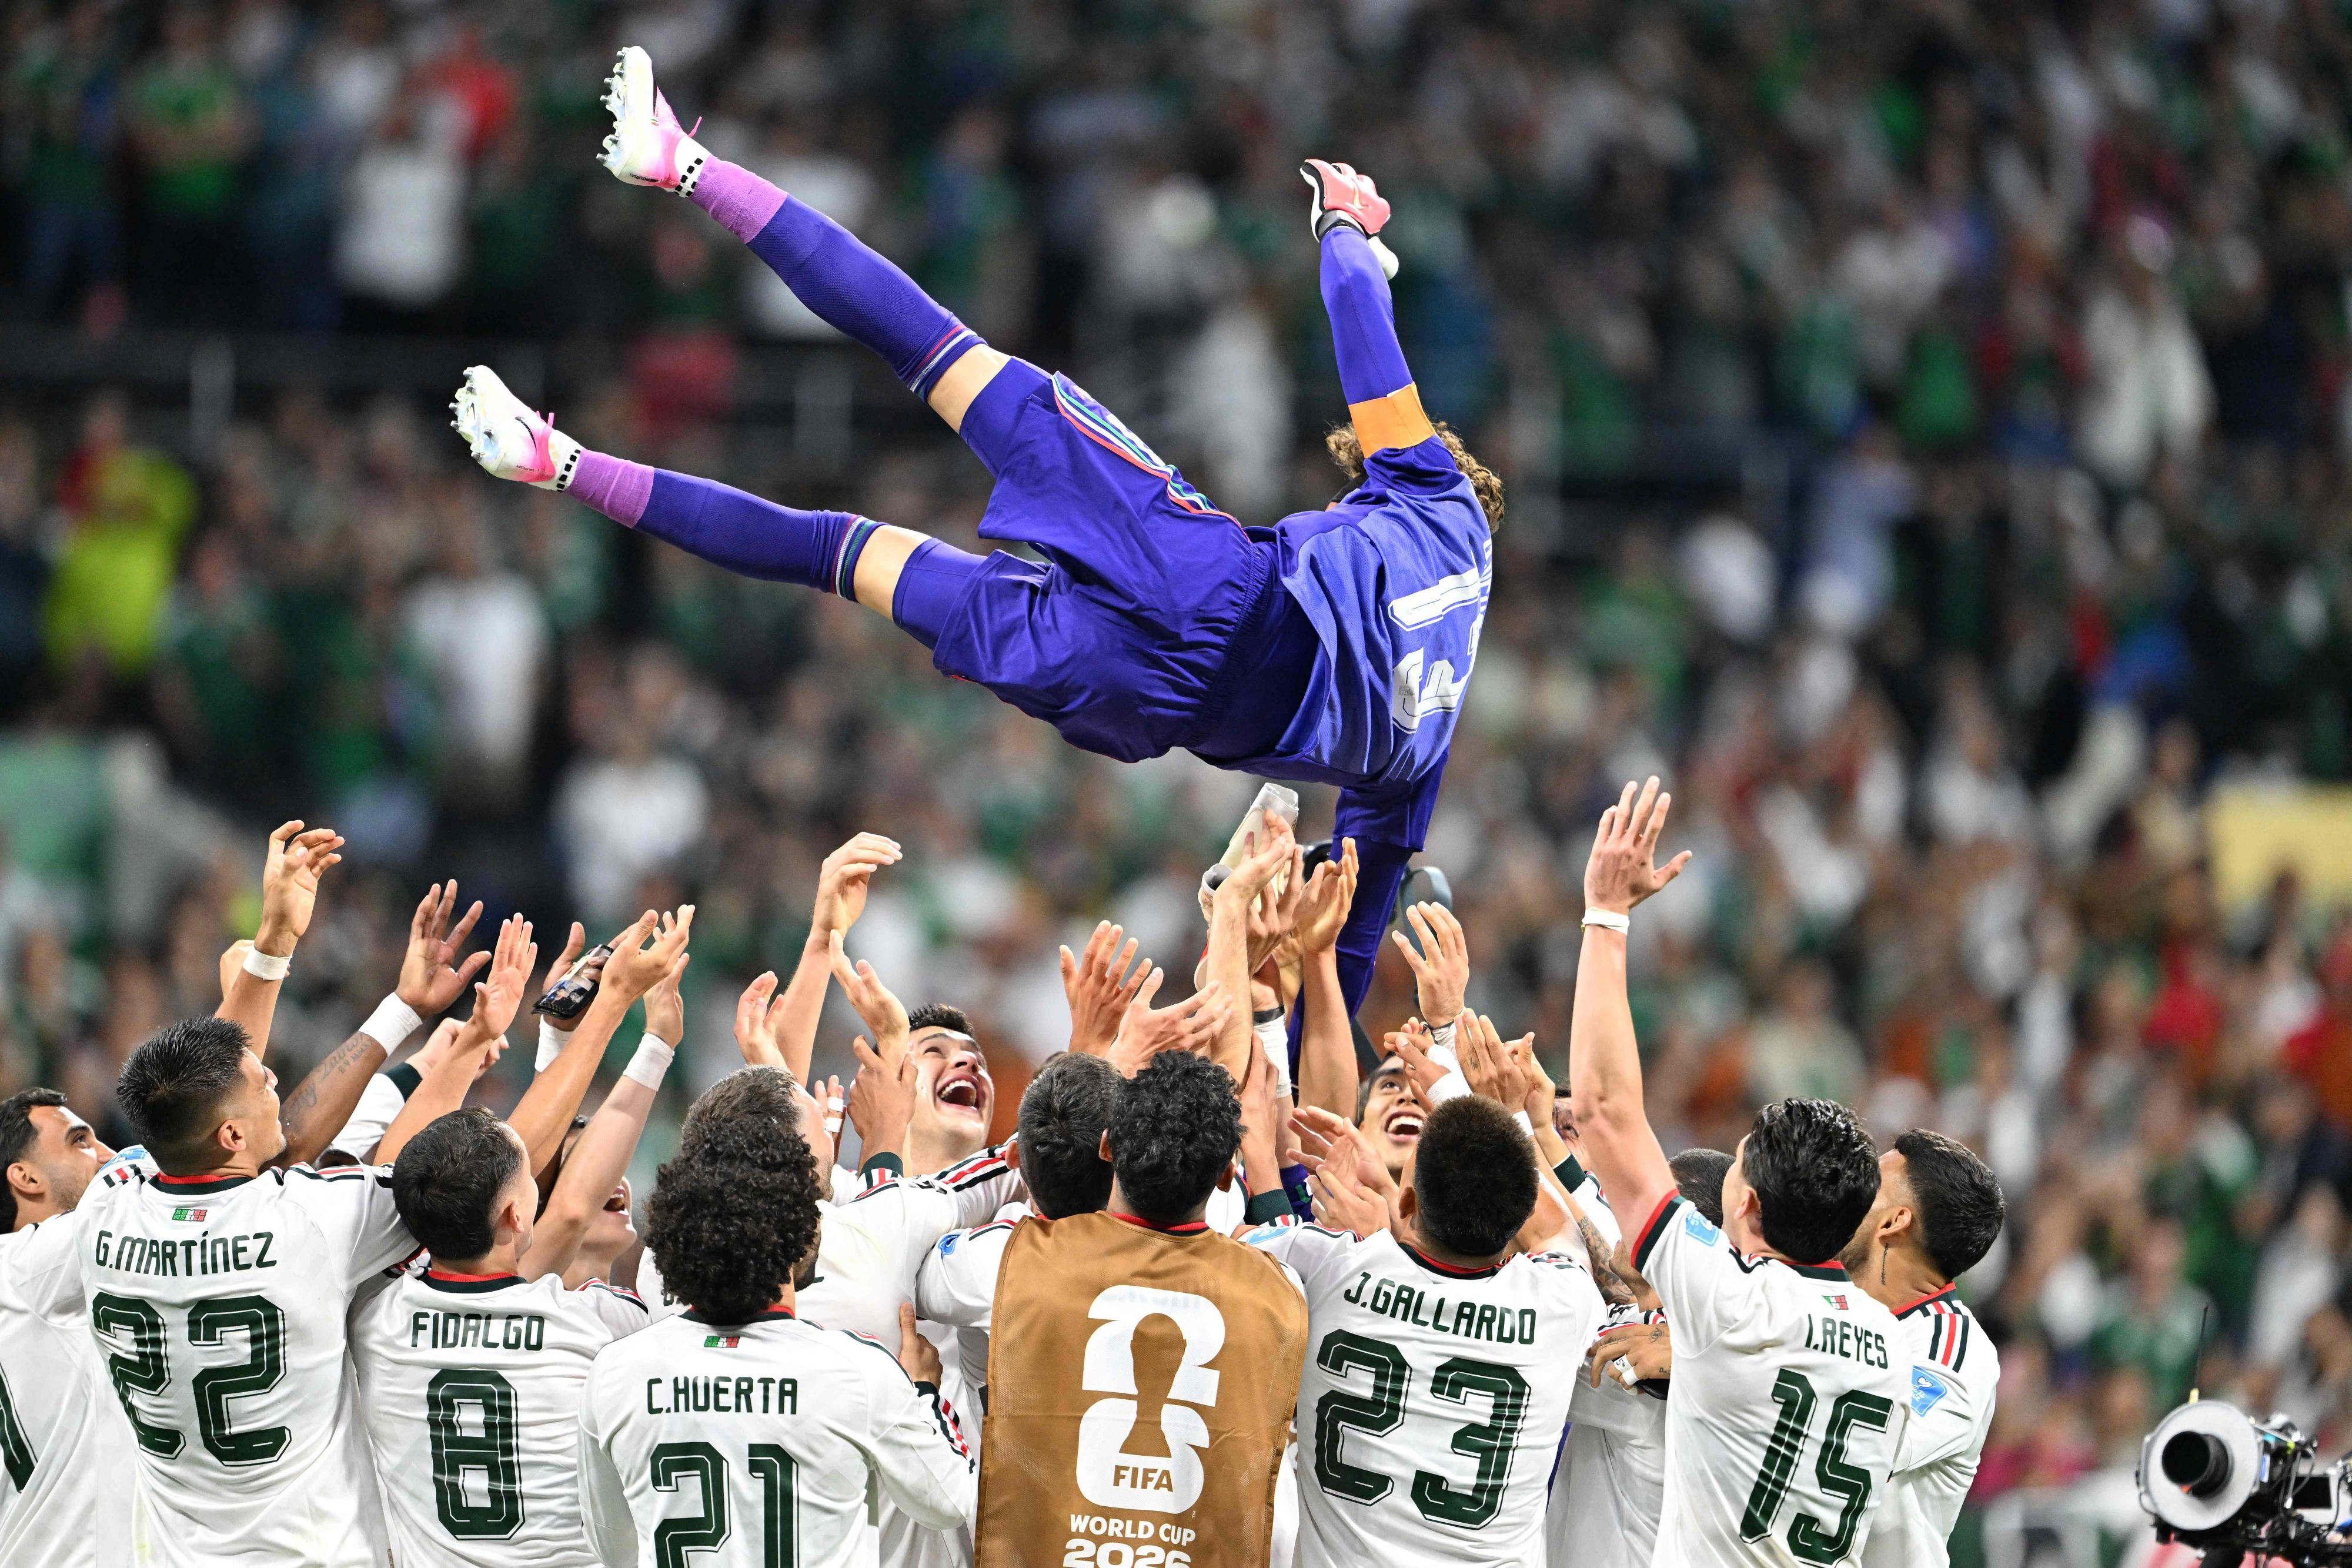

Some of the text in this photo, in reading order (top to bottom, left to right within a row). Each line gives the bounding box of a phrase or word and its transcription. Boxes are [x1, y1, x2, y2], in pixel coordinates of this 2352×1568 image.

[95, 1230, 278, 1276] G.MARTÍNEZ
[412, 1312, 545, 1351] FIDALGO
[1344, 1272, 1536, 1345] J.GALLARDO
[1806, 1313, 1889, 1369] I.REYES
[92, 1292, 292, 1467] 22
[647, 1376, 798, 1415] C.HUERTA
[427, 1369, 526, 1540] 8
[1314, 1328, 1532, 1530] 23
[1113, 1465, 1174, 1492] FIFA
[1739, 1368, 1894, 1568] 15
[650, 1442, 799, 1568] 21
[1070, 1514, 1196, 1546] WORLD CUP
[1063, 1538, 1191, 1568] 2026
